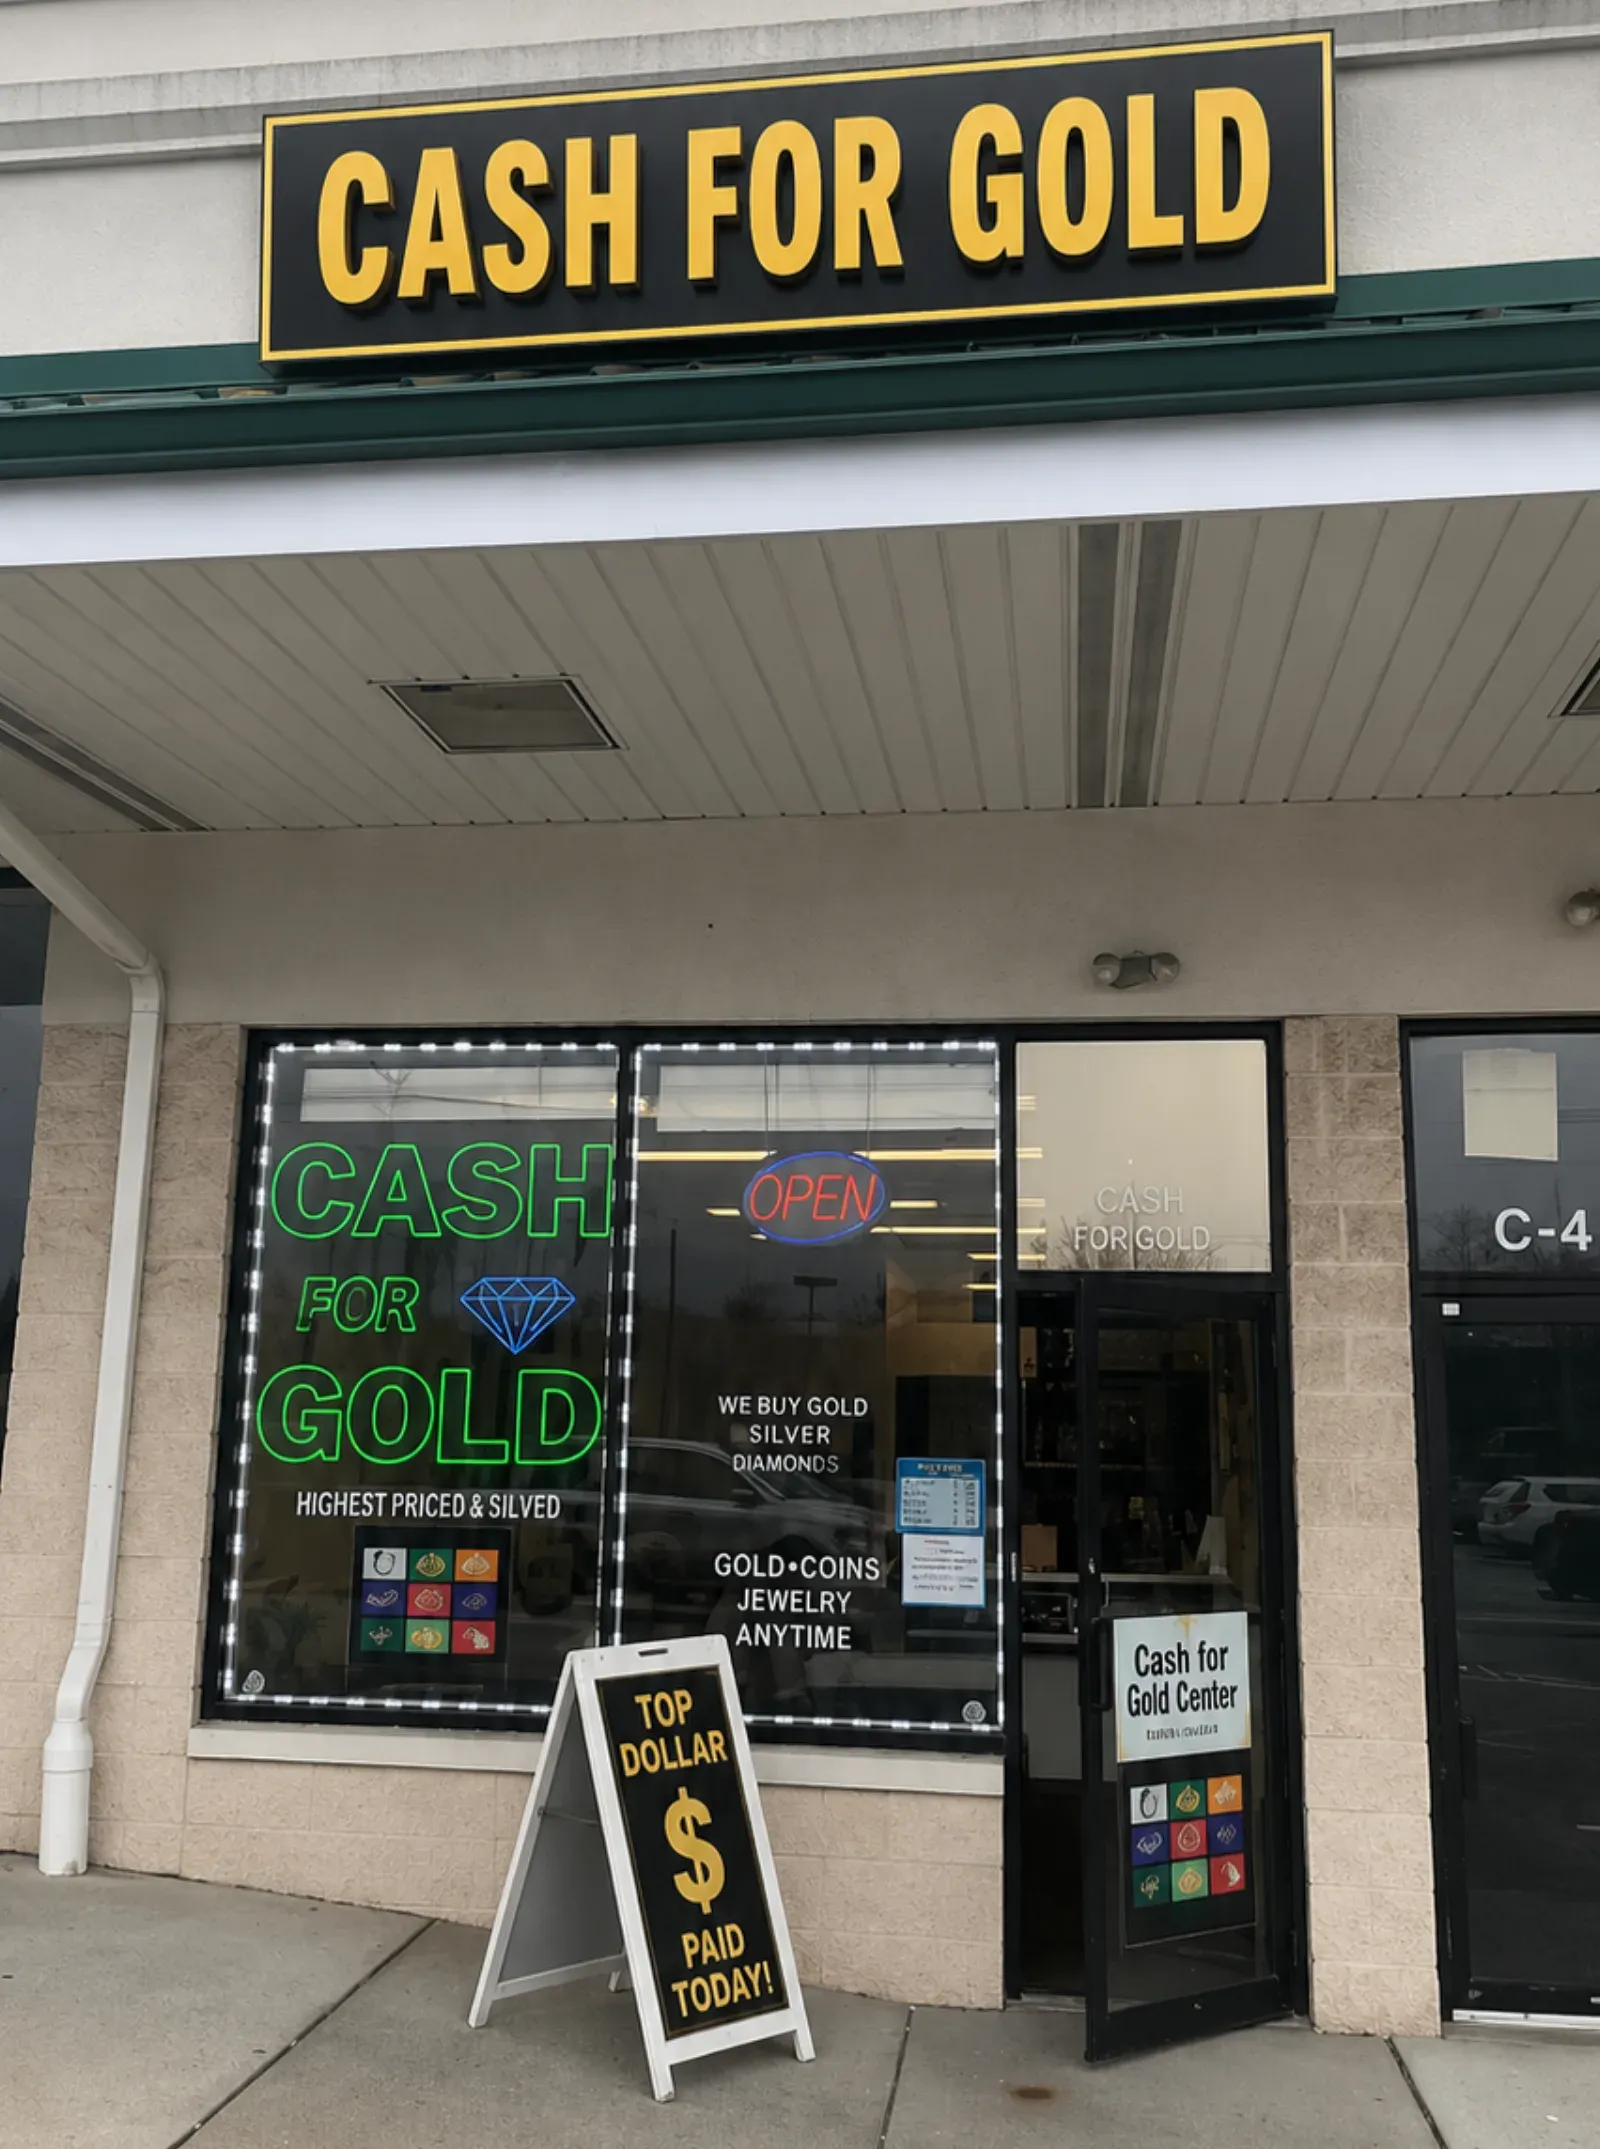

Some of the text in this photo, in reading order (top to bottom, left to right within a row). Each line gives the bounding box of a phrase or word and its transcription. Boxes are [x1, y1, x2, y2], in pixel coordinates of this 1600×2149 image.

[317, 86, 1271, 305] CASH FOR GOLD
[271, 1141, 613, 1239] CASH
[750, 1173, 878, 1221] OPEN
[1096, 1186, 1183, 1213] CASH
[1074, 1225, 1210, 1250] FOR GOLD
[1494, 1207, 1593, 1252] C-4
[296, 1276, 420, 1333] FOR
[256, 1364, 601, 1465] GOLD
[718, 1396, 868, 1416] WE BUY GOLD
[750, 1425, 830, 1444] SILVER
[733, 1454, 839, 1473] DIAMONDS
[296, 1491, 561, 1519] HIGHEST PRICED & SILVED
[737, 1588, 851, 1614] JEWELRY
[735, 1623, 852, 1650] ANYTIME
[1134, 1640, 1228, 1677] Cash for
[634, 1689, 693, 1730] TOP
[1127, 1679, 1238, 1717] Gold Center
[620, 1729, 728, 1777] DOLLAR
[664, 1786, 726, 1915] $
[681, 1922, 745, 1969] PAID
[672, 1960, 774, 2018] TODAY!
